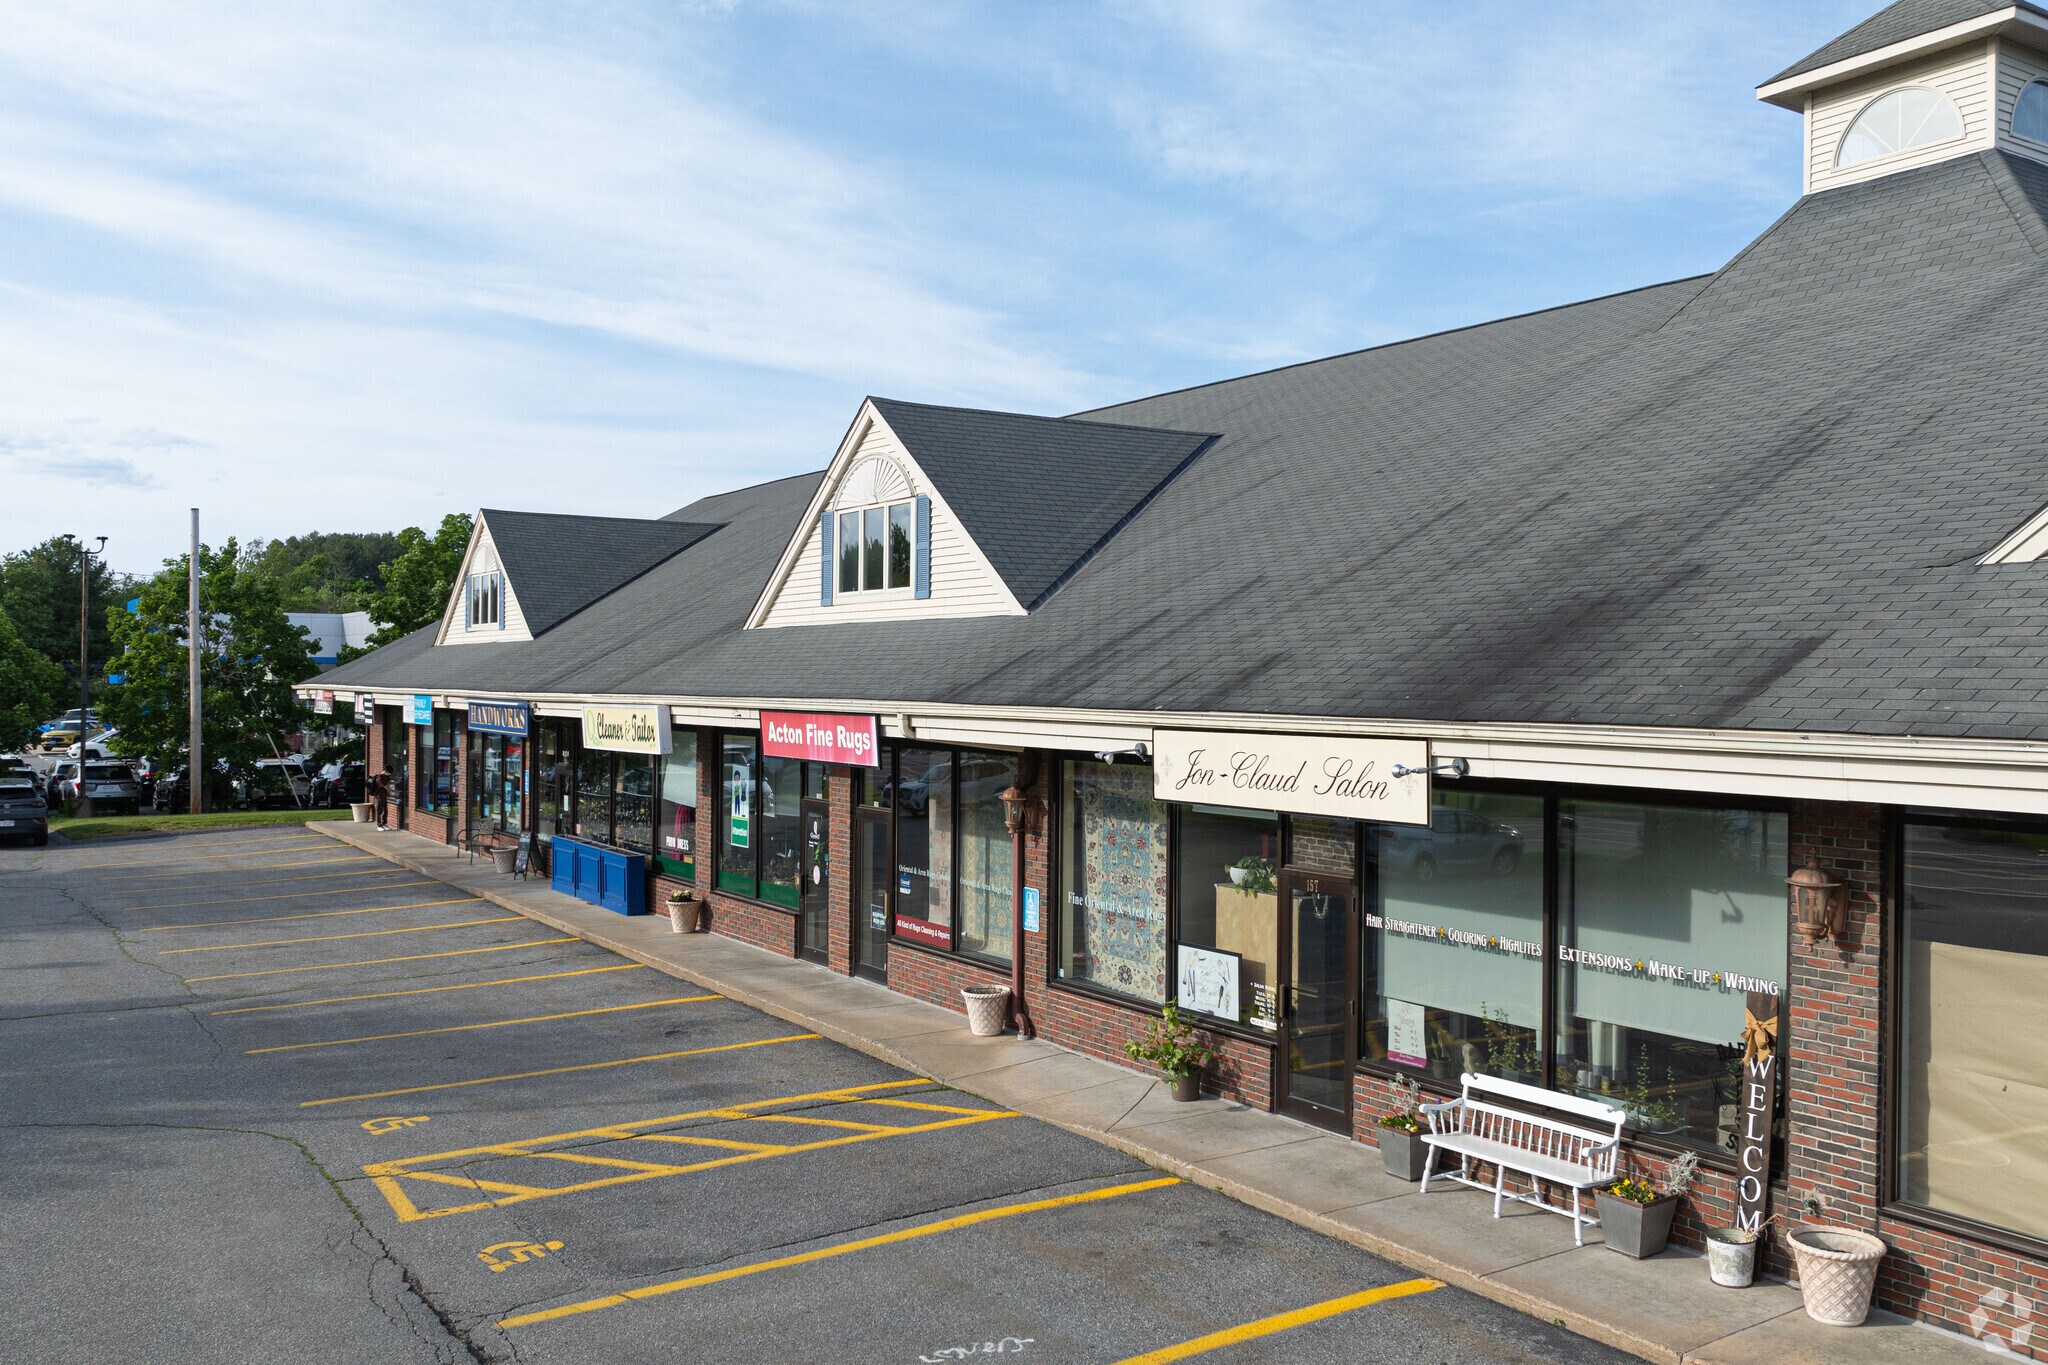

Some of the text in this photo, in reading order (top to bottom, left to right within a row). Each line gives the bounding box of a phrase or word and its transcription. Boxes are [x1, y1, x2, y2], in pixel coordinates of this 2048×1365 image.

[470, 705, 525, 729] HANDWORKS
[597, 713, 624, 740] Cleaner
[625, 720, 631, 741] &
[631, 714, 655, 742] Tailor
[768, 721, 871, 755] Acton Fine Rugs
[1175, 749, 1390, 799] Jon-Claud Salon
[898, 864, 914, 874] Oriental
[918, 868, 926, 877] Area
[1306, 879, 1319, 892] 157
[1068, 891, 1167, 923] Fine Oriental & Area Rugs
[921, 926, 935, 937] Cleaning
[1366, 913, 1383, 929] HAIR
[1385, 916, 1437, 938] STRAIGHTENER
[1500, 935, 1543, 957] HIGHLITES
[1559, 945, 1780, 996] EXTENSIONS MAKE-UP WAXING
[1736, 1053, 1774, 1231] WELCOM
